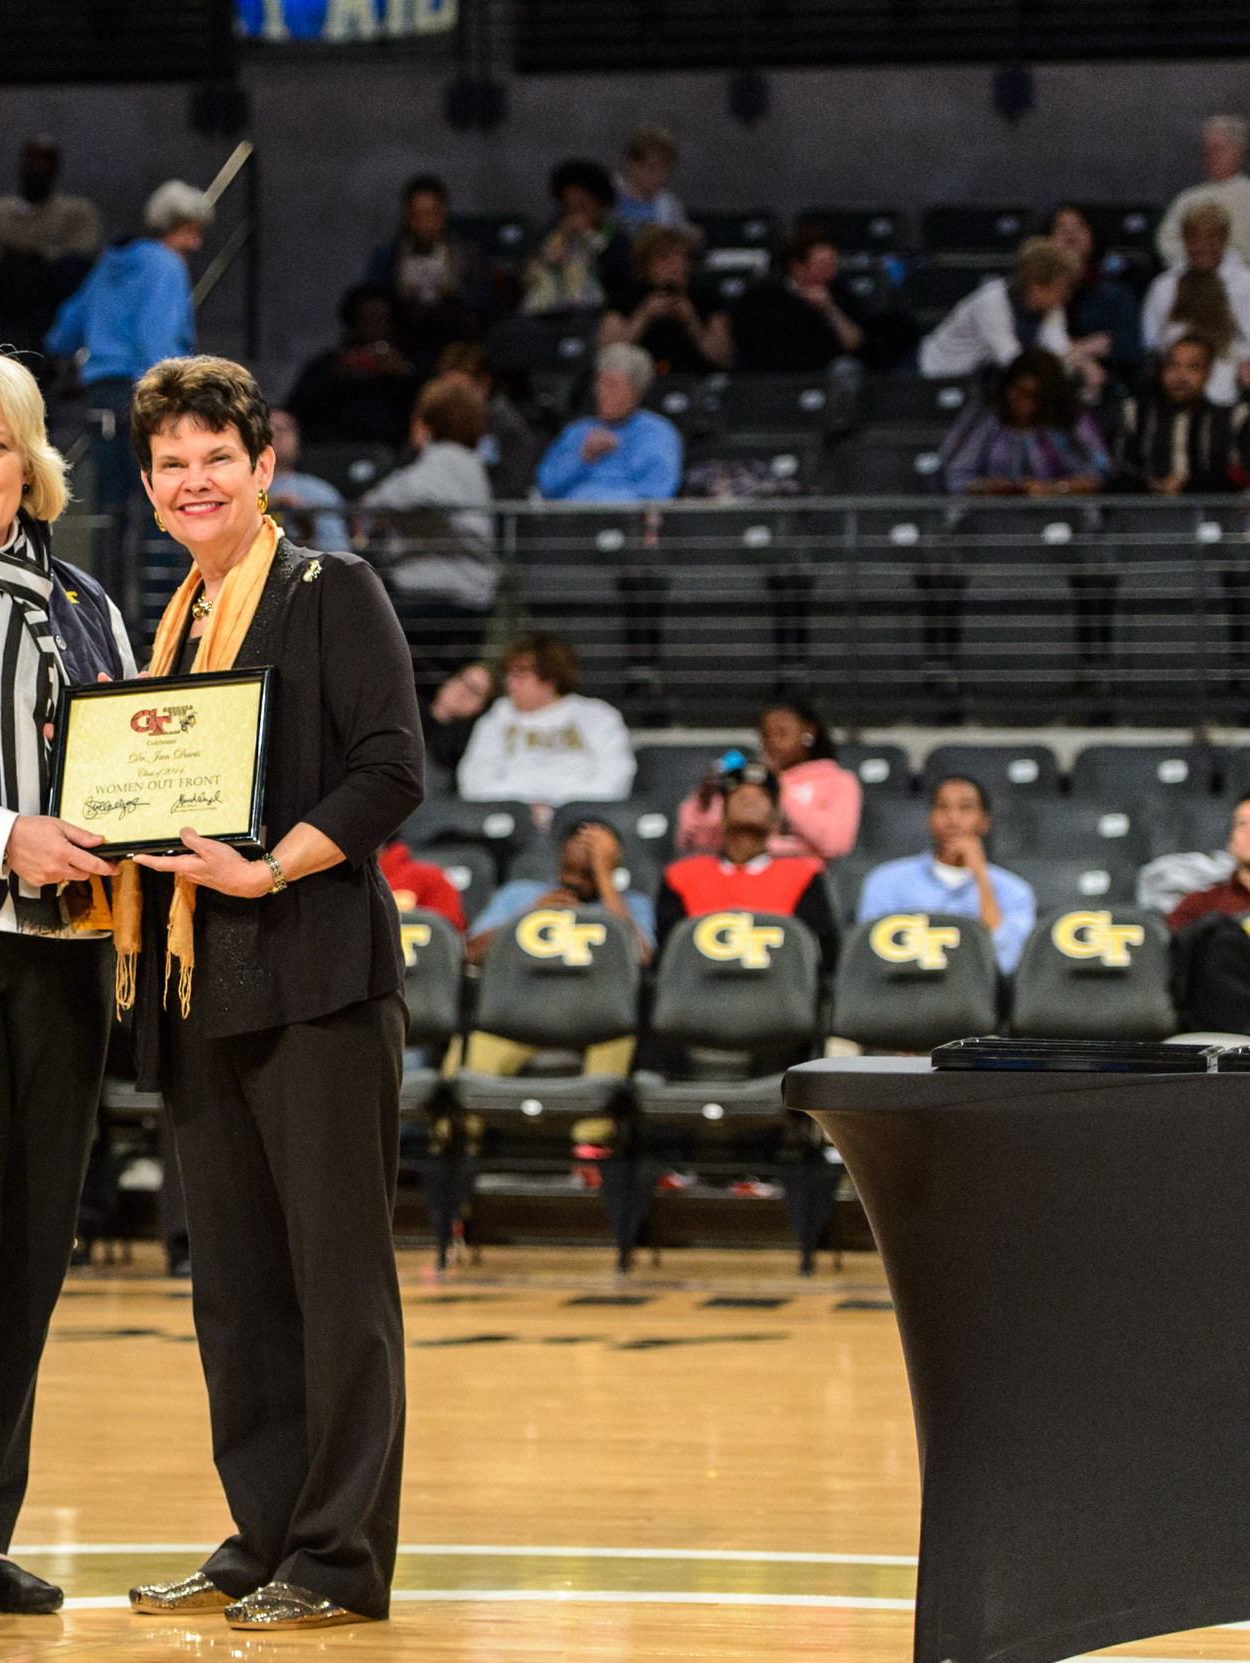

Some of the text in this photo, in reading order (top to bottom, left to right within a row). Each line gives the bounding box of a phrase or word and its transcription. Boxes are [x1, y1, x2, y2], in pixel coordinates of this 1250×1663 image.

[130, 708, 173, 735] GT
[95, 775, 222, 795] WOMEN OUT FRONT
[516, 909, 607, 966] GT
[693, 912, 785, 969] GT
[869, 913, 961, 970] GT
[1052, 910, 1144, 967] GT
